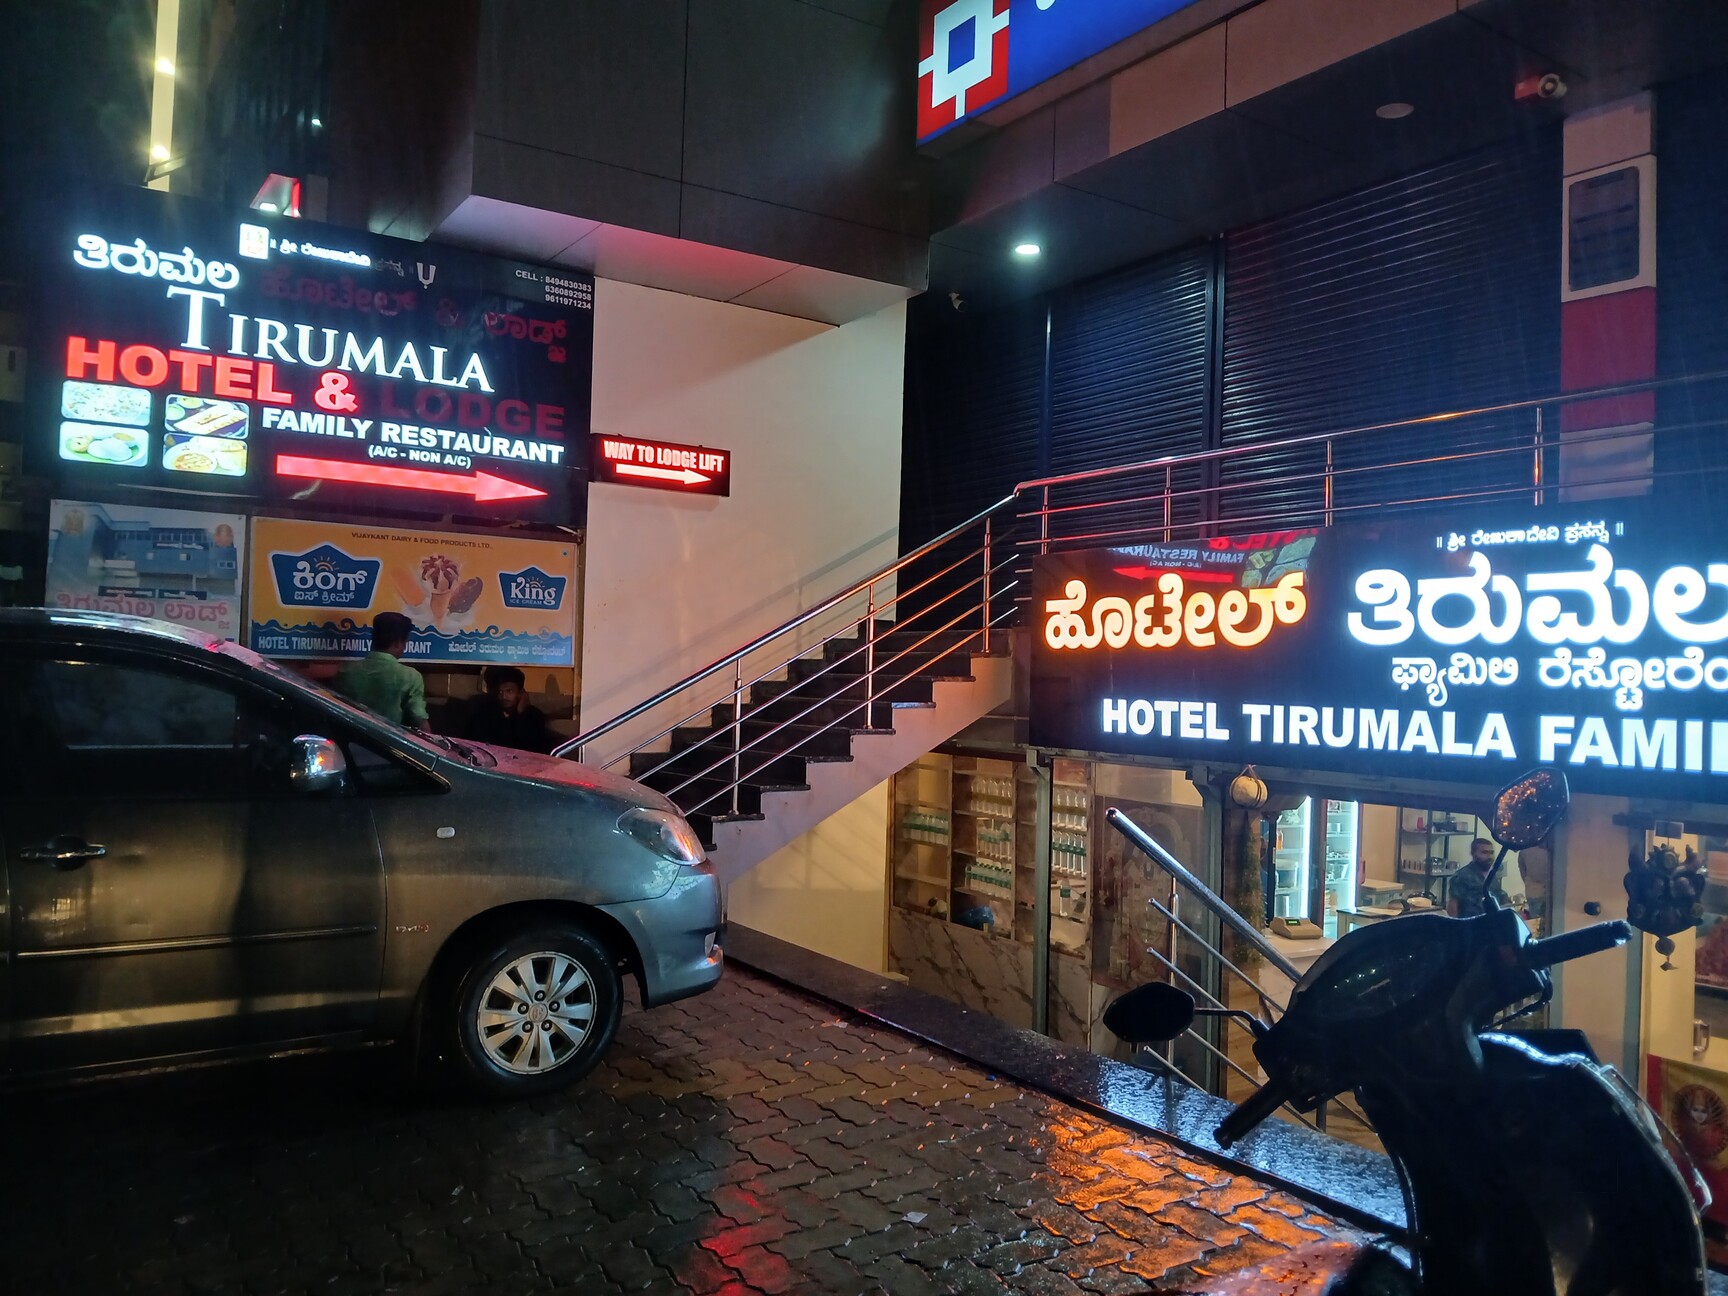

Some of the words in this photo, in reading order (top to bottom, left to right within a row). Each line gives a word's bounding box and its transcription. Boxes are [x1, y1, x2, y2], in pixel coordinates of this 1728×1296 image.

[73, 234, 240, 290] ತಿರುಮಲ
[515, 269, 538, 281] CELL
[545, 276, 592, 292] 8494830383
[166, 285, 495, 393] TIRUMALA
[66, 336, 292, 404] HOTEL
[313, 371, 358, 412] &
[381, 380, 565, 440] LODGE
[262, 407, 373, 440] FAMILY
[381, 422, 565, 465] RESTAURANT
[368, 444, 398, 458] (A/C
[409, 449, 441, 464] NON
[443, 453, 472, 469] A/C)
[603, 440, 635, 461] WAY
[637, 445, 654, 463] TO
[657, 447, 697, 469] LODGE
[699, 453, 724, 472] LIFT
[391, 535, 412, 543] DAIRY
[420, 537, 439, 545] FOOD
[441, 540, 476, 548] PRODUCTS
[510, 576, 556, 606] King
[1045, 572, 1306, 649] ಹೊಟೇಲ್
[1348, 544, 1728, 646] ತಿರುಮಲ
[258, 636, 289, 650] HOTEL
[292, 637, 338, 650] TIRUMALA
[341, 639, 372, 652] FAMILY
[1392, 652, 1519, 707] ಫ್ಯಾಮಿಲಿ
[1103, 698, 1229, 740] HOTEL
[1242, 703, 1517, 759] TIRUMALA
